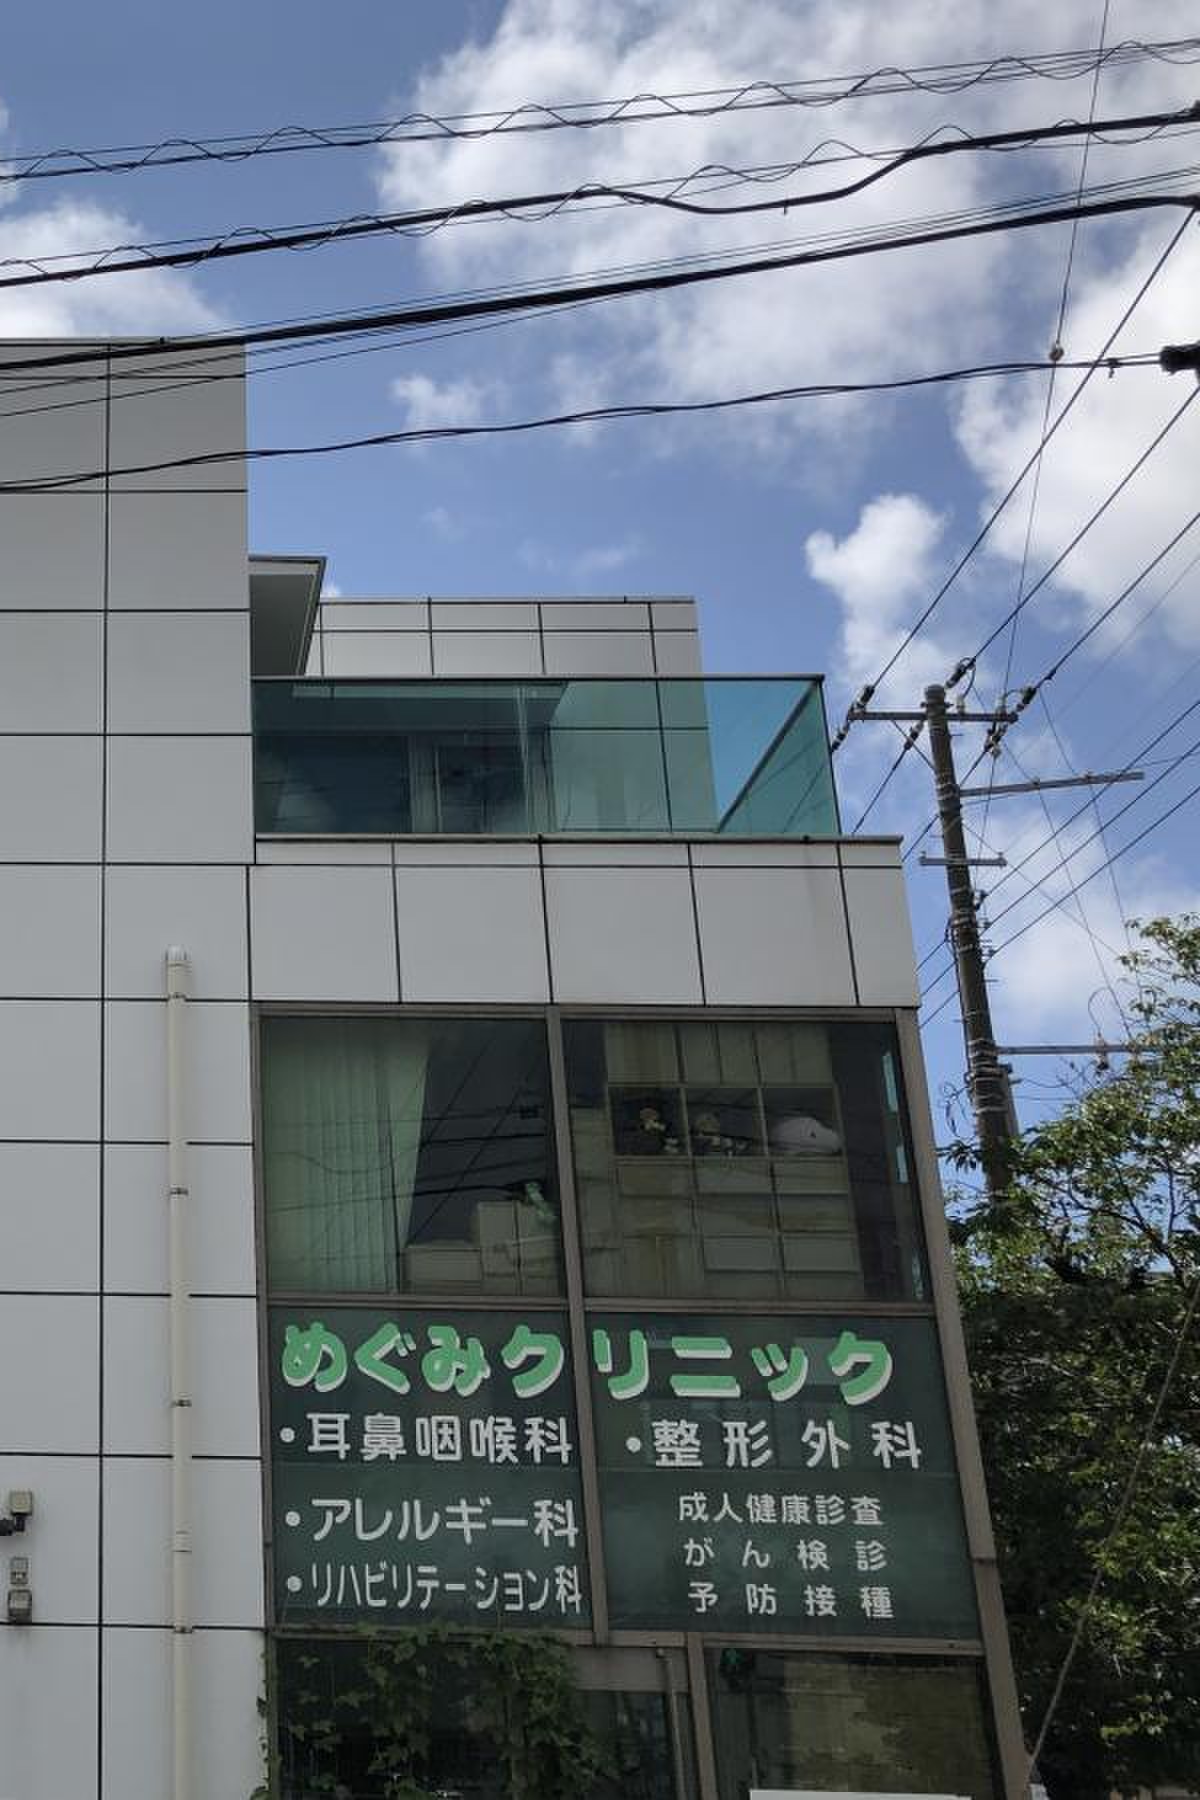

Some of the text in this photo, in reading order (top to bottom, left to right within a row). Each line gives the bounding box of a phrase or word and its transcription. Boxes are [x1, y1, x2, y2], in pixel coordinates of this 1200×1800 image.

[282, 1322, 892, 1405] めぐみクリニック
[306, 1412, 573, 1464] 耳鼻咽喉科
[652, 1419, 922, 1468] 整形外科
[311, 1496, 579, 1548] アレルギー科
[678, 1492, 884, 1526] 成人健康診査
[684, 1537, 887, 1571] がん検診
[311, 1560, 582, 1614] リハビリテーション科
[688, 1581, 895, 1619] 予防接種
